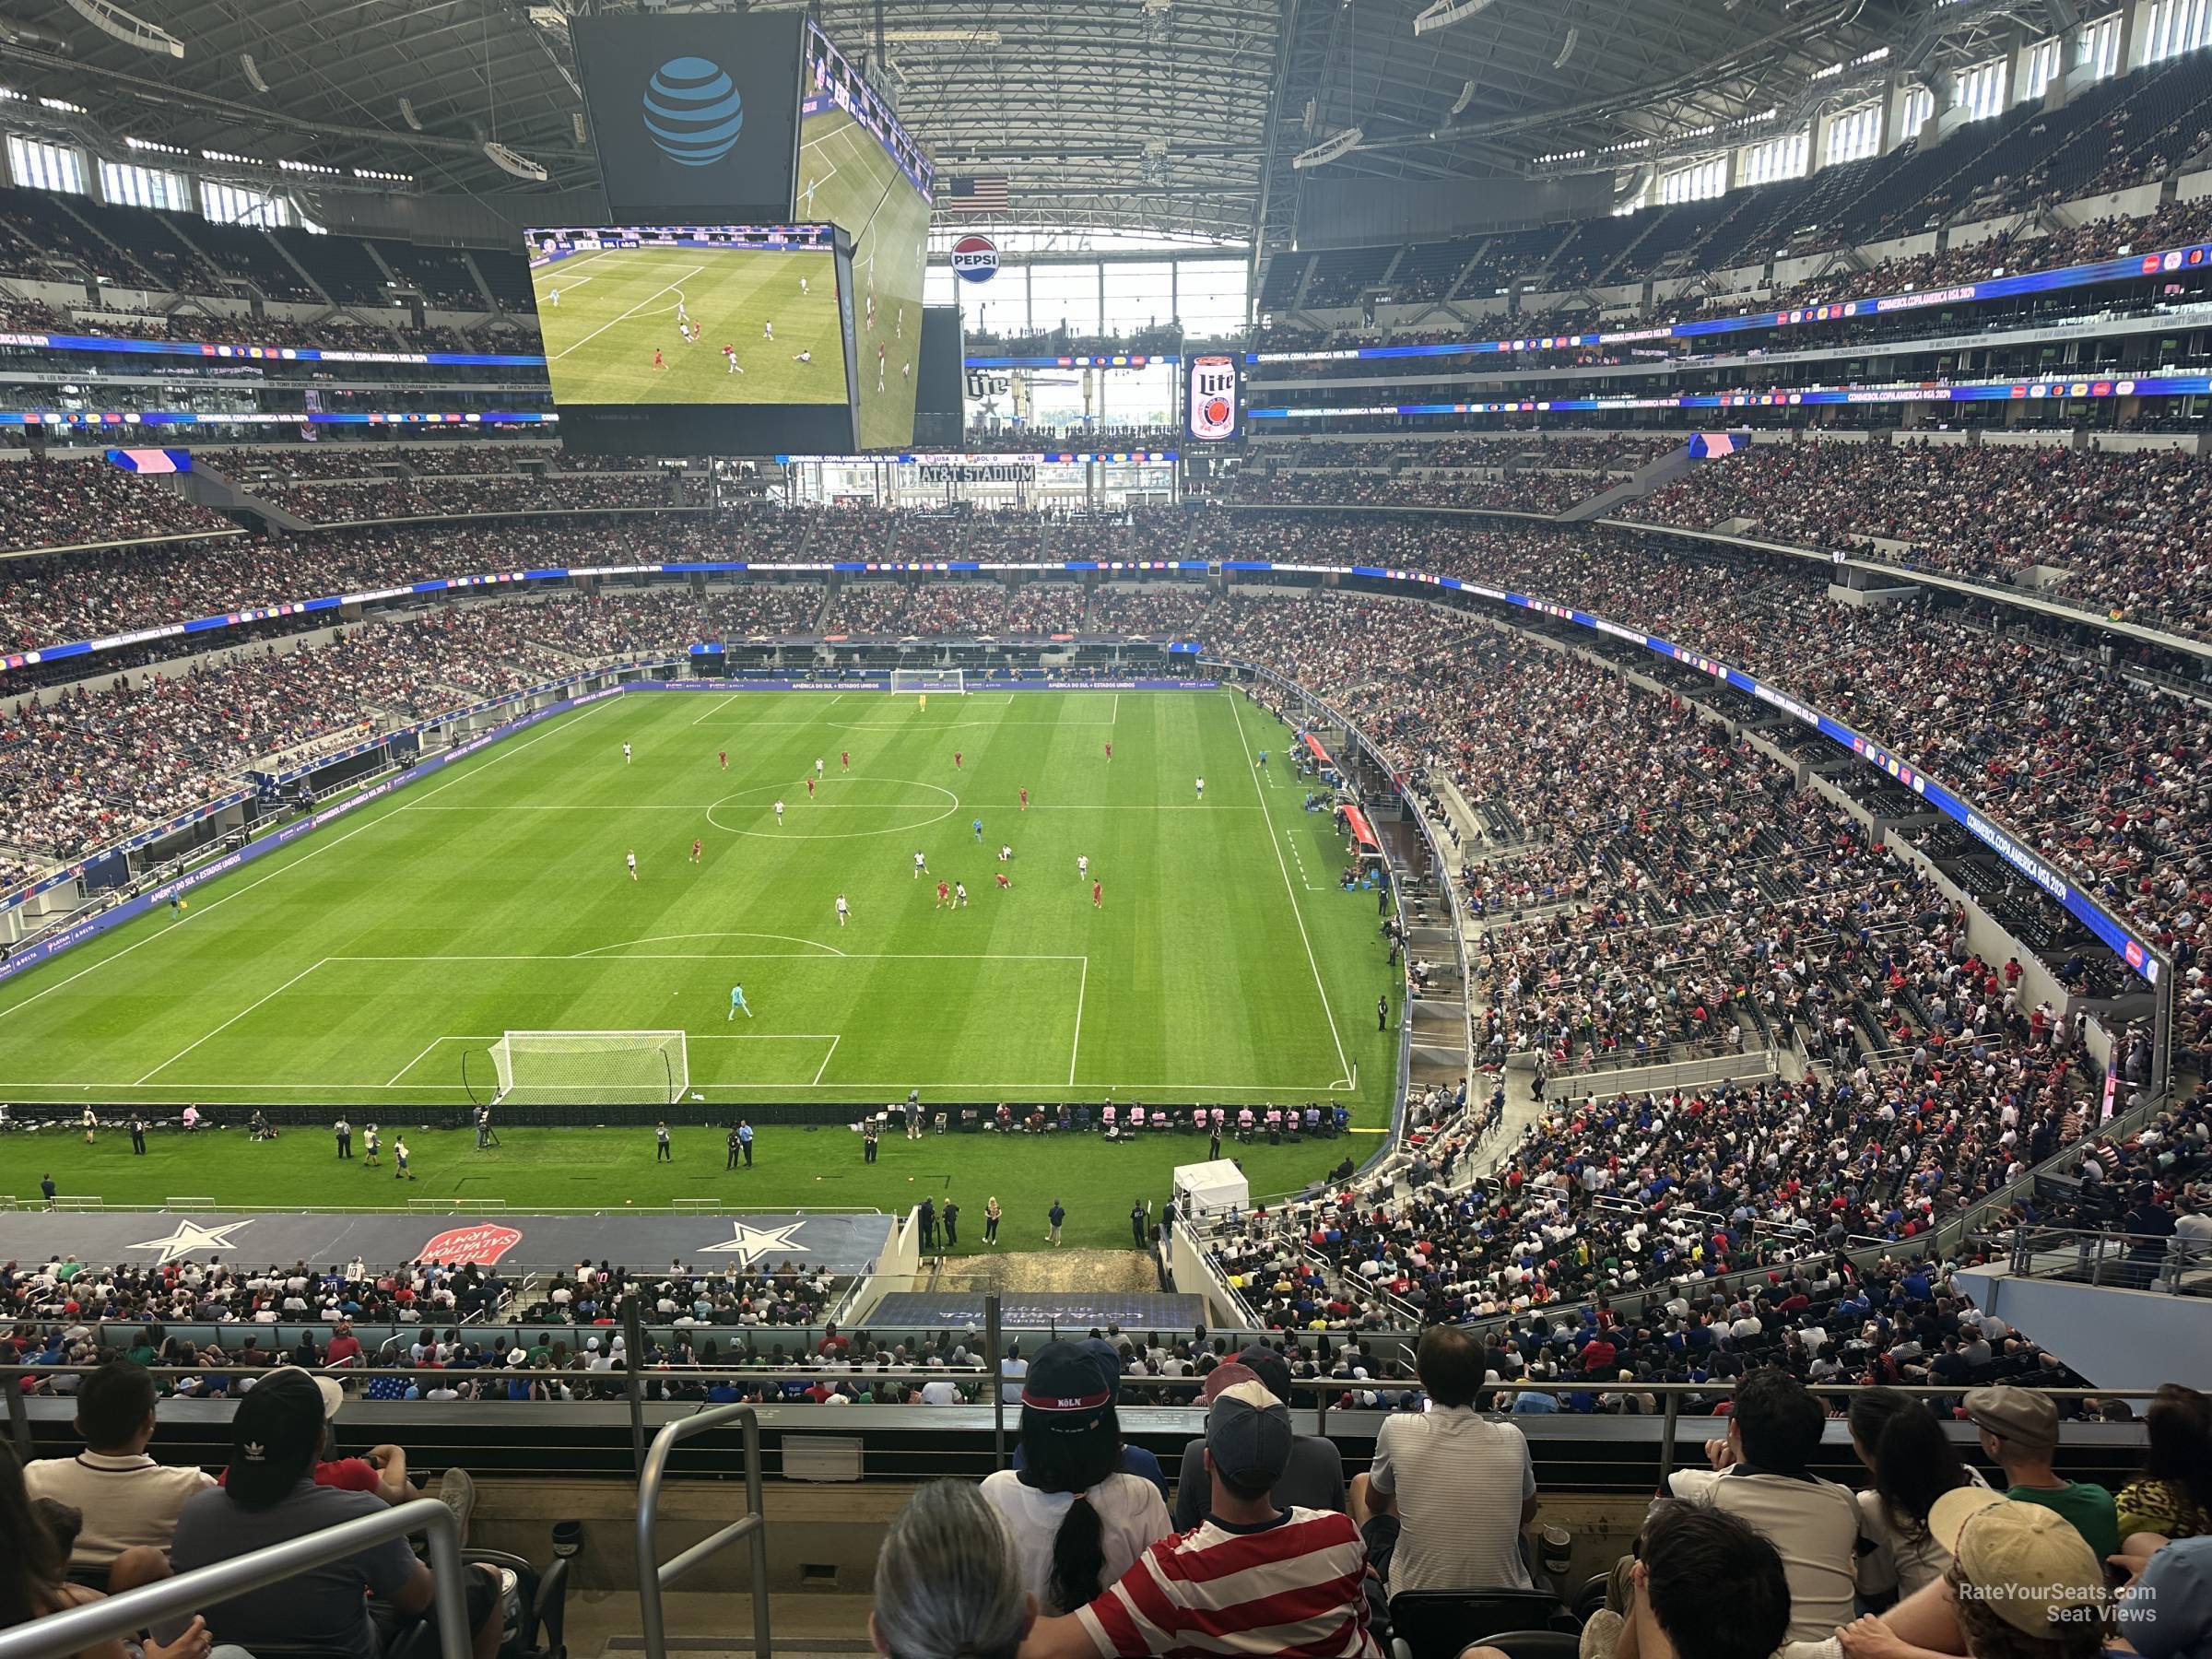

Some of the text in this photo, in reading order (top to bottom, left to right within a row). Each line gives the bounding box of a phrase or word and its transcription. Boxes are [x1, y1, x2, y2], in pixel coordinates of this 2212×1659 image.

[954, 255, 996, 265] PEPSI
[2186, 315, 2207, 324] SMITH
[1199, 374, 1233, 396] Lite
[922, 466, 1035, 481] AT&T STADIUM
[1967, 813, 2067, 900] CONMEBOL COPA AMERICA USA 2024
[176, 881, 184, 891] DO
[185, 876, 195, 886] SUL
[200, 862, 222, 879] ESTADOS
[222, 854, 241, 869] UNIDOS
[53, 935, 70, 946] LATAM
[21, 953, 37, 964] DELTA
[1468, 1206, 1474, 1215] 8
[437, 1229, 497, 1249] ARMY
[422, 1235, 517, 1261] SALVATION
[450, 1249, 489, 1263] THE
[349, 1268, 357, 1277] 10
[597, 1272, 608, 1282] 10
